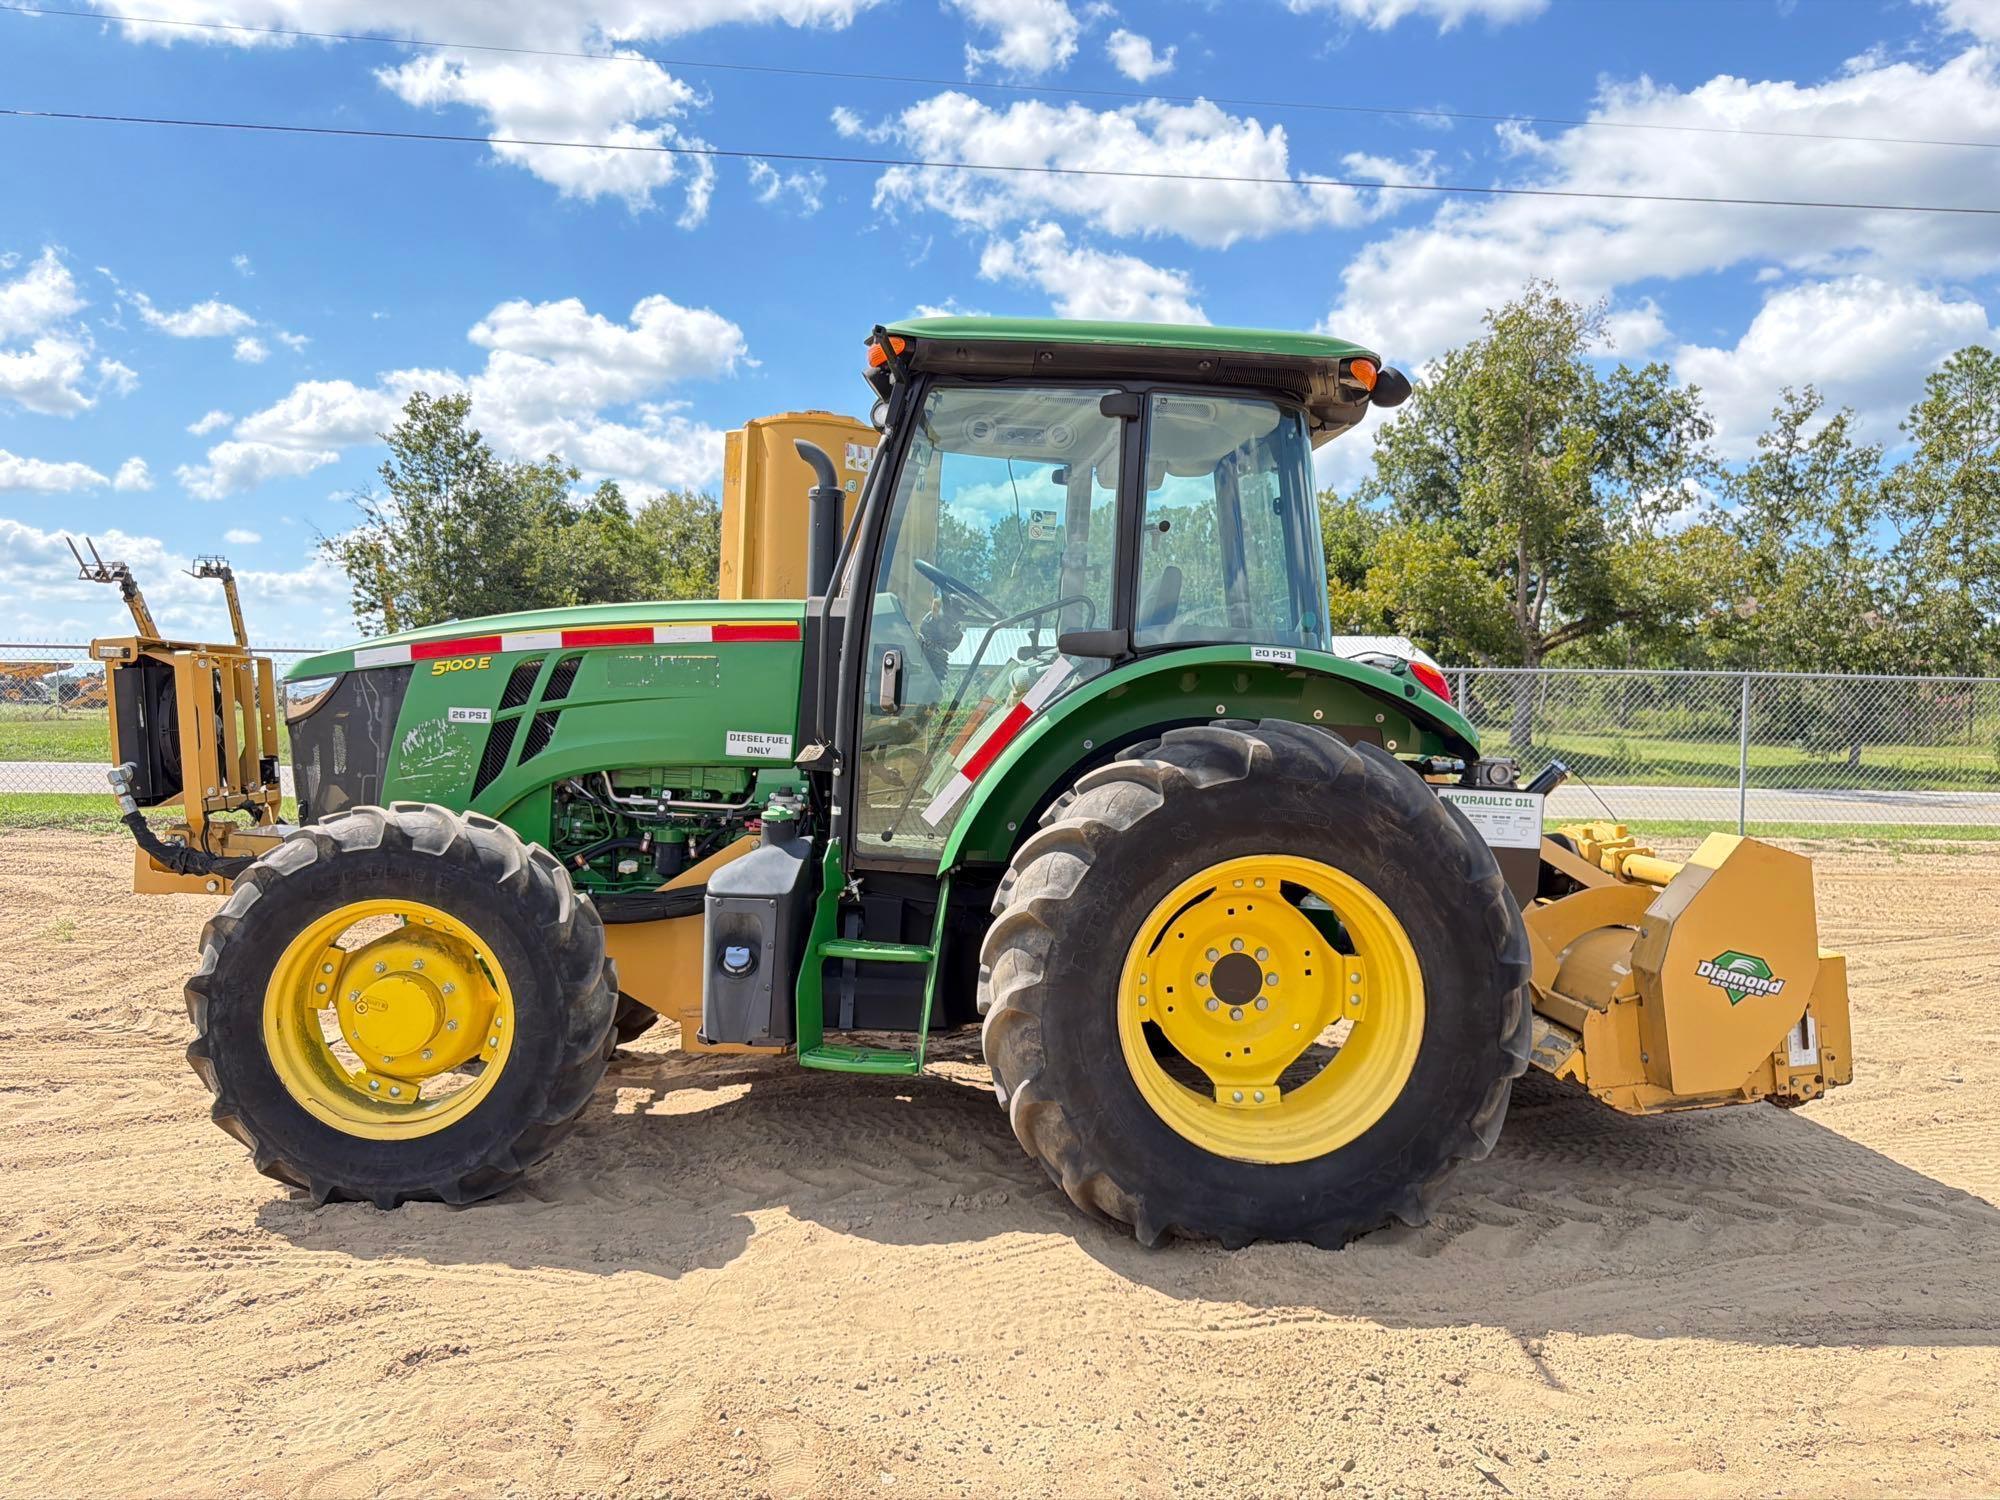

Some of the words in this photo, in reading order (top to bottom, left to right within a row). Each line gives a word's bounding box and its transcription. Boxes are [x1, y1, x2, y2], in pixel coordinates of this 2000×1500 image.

[1255, 649, 1270, 657] 20
[1272, 650, 1293, 659] PSI
[431, 657, 476, 676] 5100
[477, 656, 492, 669] E
[452, 710, 466, 719] 26
[468, 711, 488, 719] PSI
[729, 733, 765, 743] DIESEL
[766, 736, 790, 744] FUEL
[746, 746, 772, 755] ONLY
[1446, 794, 1513, 807] HYDRAULIC
[1514, 798, 1535, 808] OIL
[1696, 960, 1785, 995] Diamond
[1710, 978, 1765, 996] MOWERS
